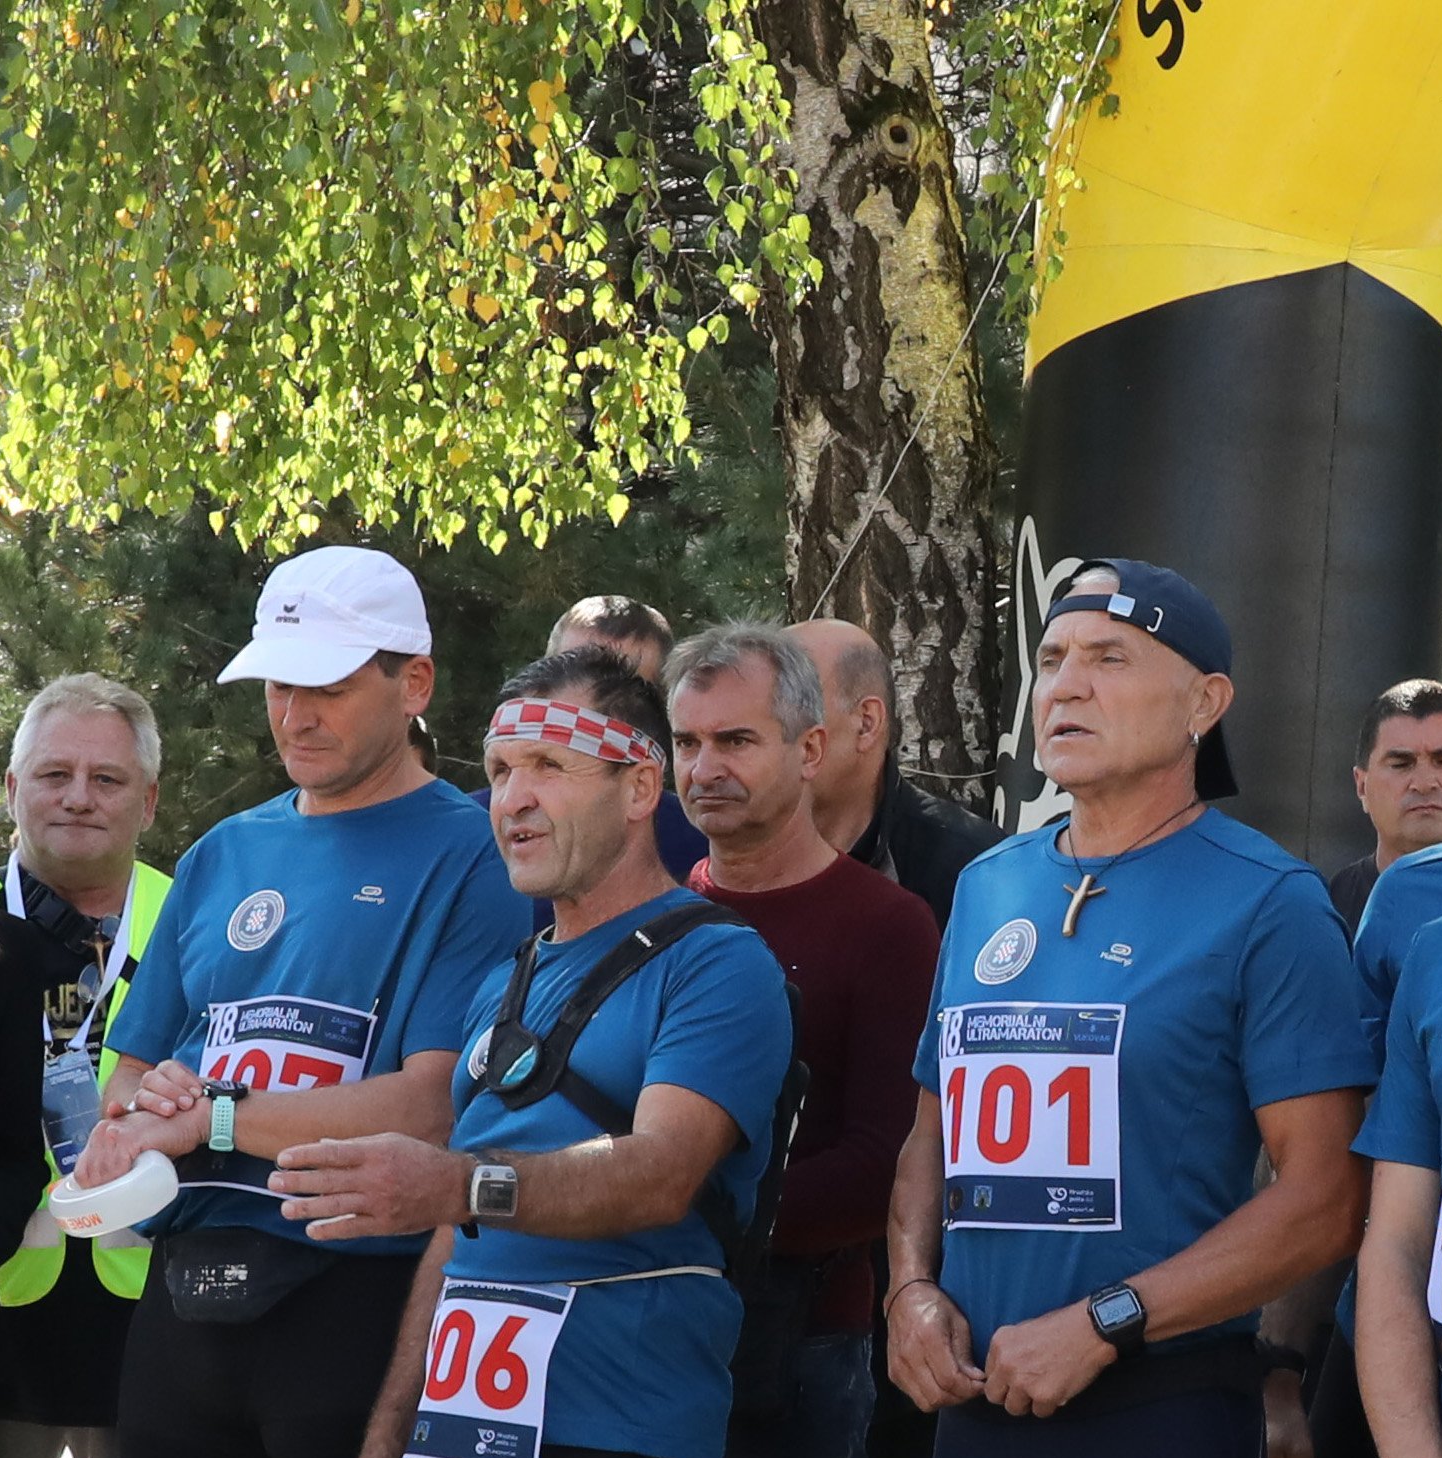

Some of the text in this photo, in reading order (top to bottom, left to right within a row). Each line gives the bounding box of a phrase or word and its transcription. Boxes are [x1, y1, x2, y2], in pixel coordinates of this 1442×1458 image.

[967, 1014, 1047, 1029] MEMORIJALNI
[966, 1027, 1063, 1042] ULTRAMARATON
[947, 1064, 1091, 1167] 101
